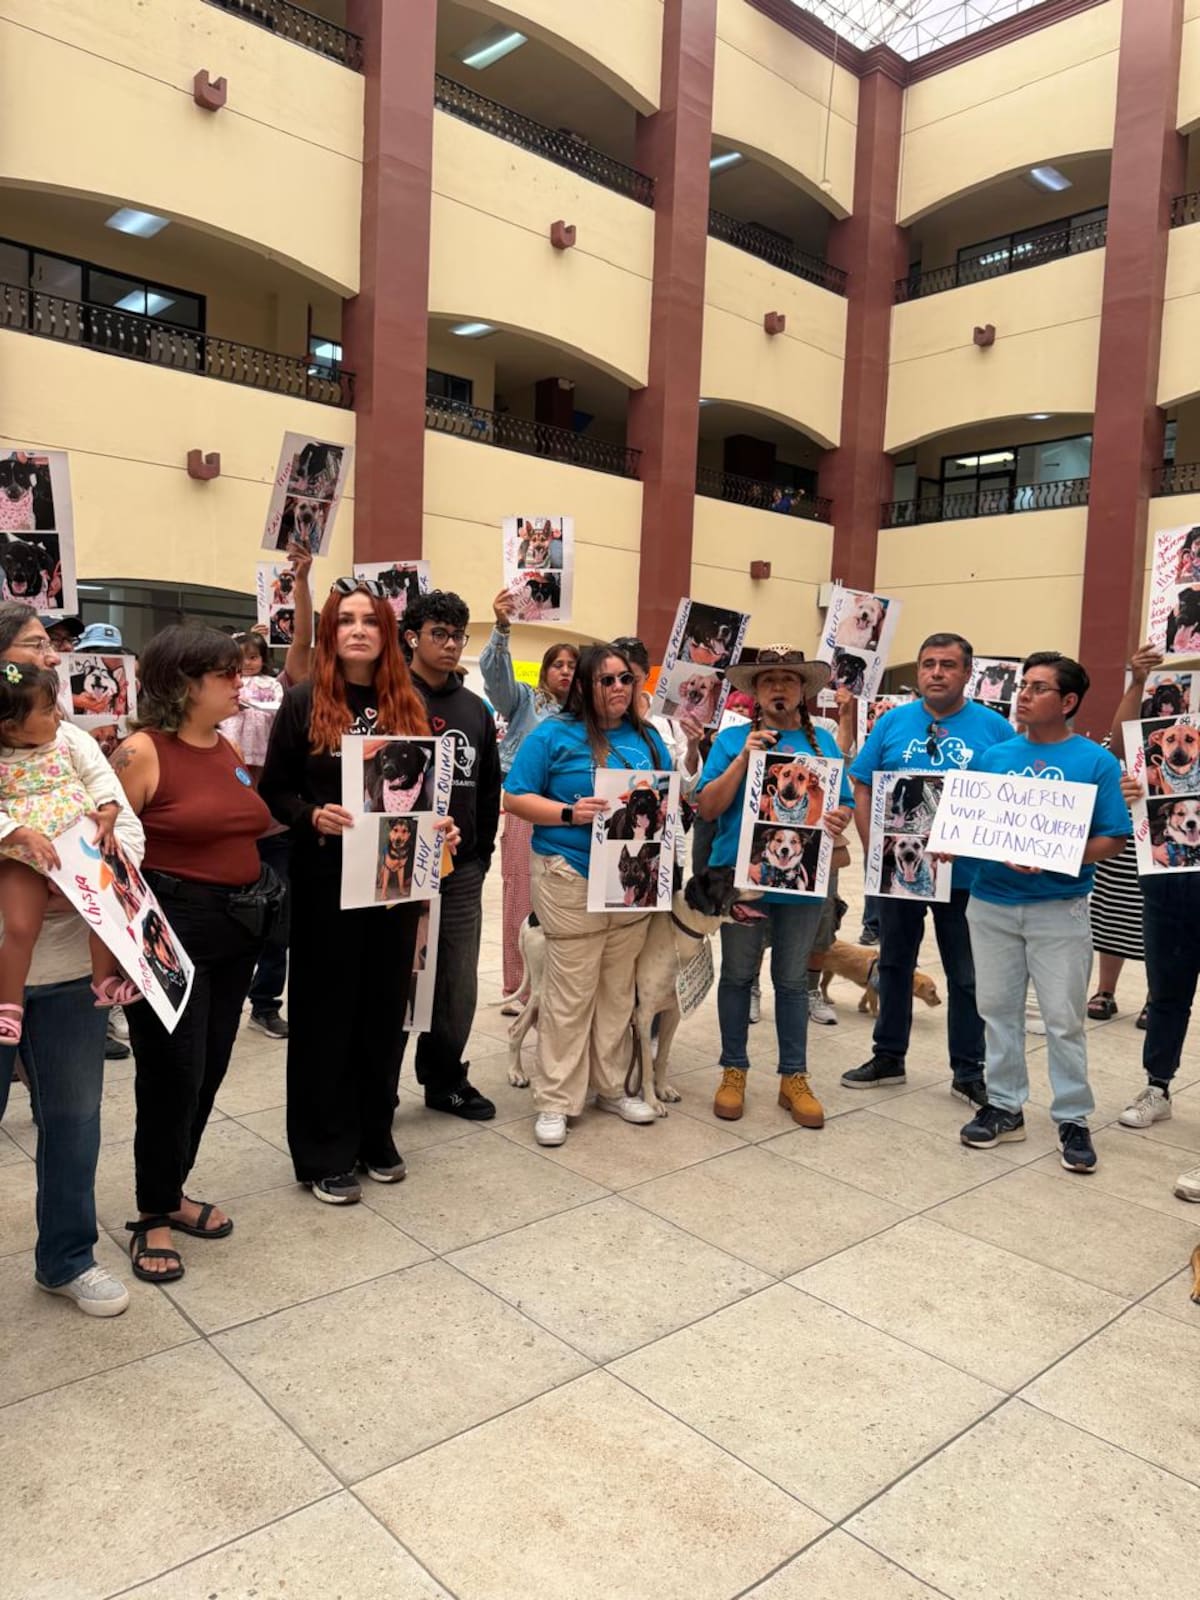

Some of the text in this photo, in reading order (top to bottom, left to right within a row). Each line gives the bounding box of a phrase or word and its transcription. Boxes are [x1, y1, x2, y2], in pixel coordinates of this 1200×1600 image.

[657, 680, 671, 700] NO
[667, 648, 679, 671] ES
[437, 737, 452, 794] QUIMIO
[749, 758, 765, 815] BRUNO
[436, 794, 450, 817] MI
[1030, 813, 1087, 840] QUIEREN
[940, 822, 961, 841] LA
[413, 834, 432, 889] CHUY
[656, 862, 671, 903] SIN
[867, 843, 884, 890] ZEUS
[74, 874, 103, 926] Chispa
